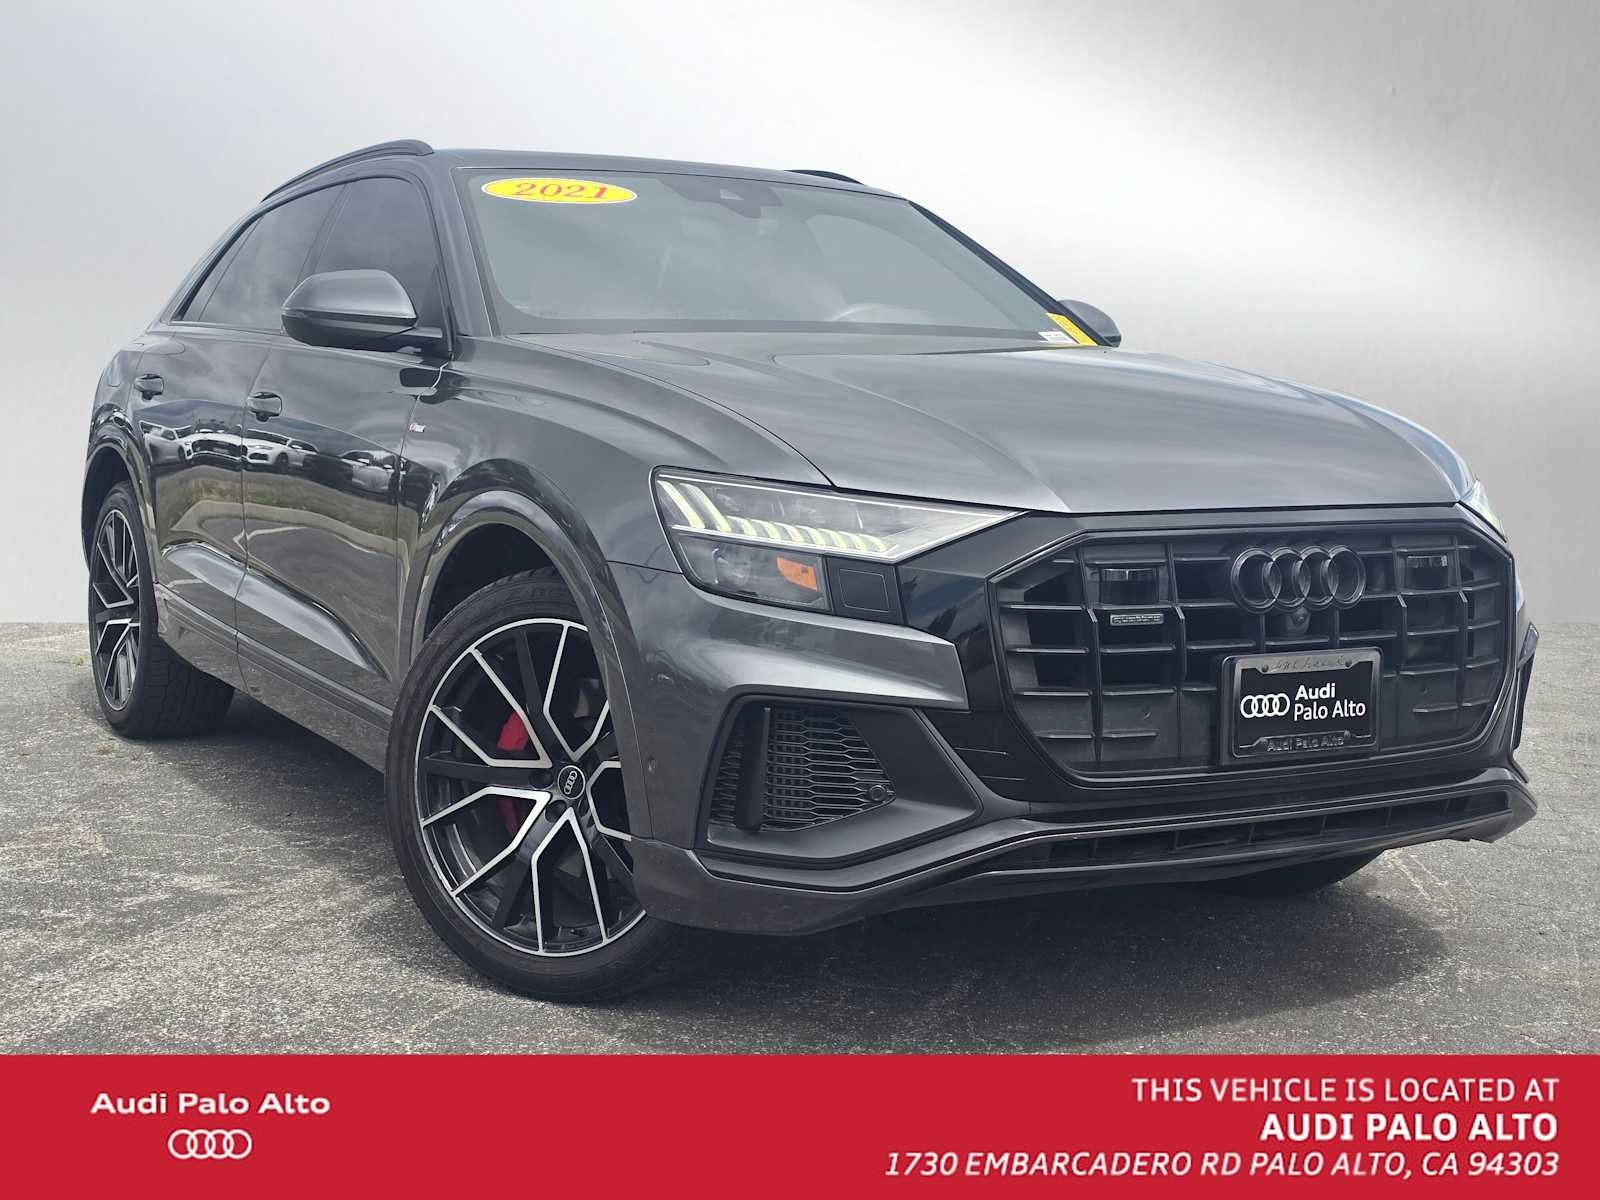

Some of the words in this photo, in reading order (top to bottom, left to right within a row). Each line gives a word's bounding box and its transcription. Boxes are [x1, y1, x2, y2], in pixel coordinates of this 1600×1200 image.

[512, 182, 608, 199] 2021
[1294, 682, 1336, 701] Audi
[1293, 701, 1329, 722] Palo
[1331, 699, 1367, 718] Alto
